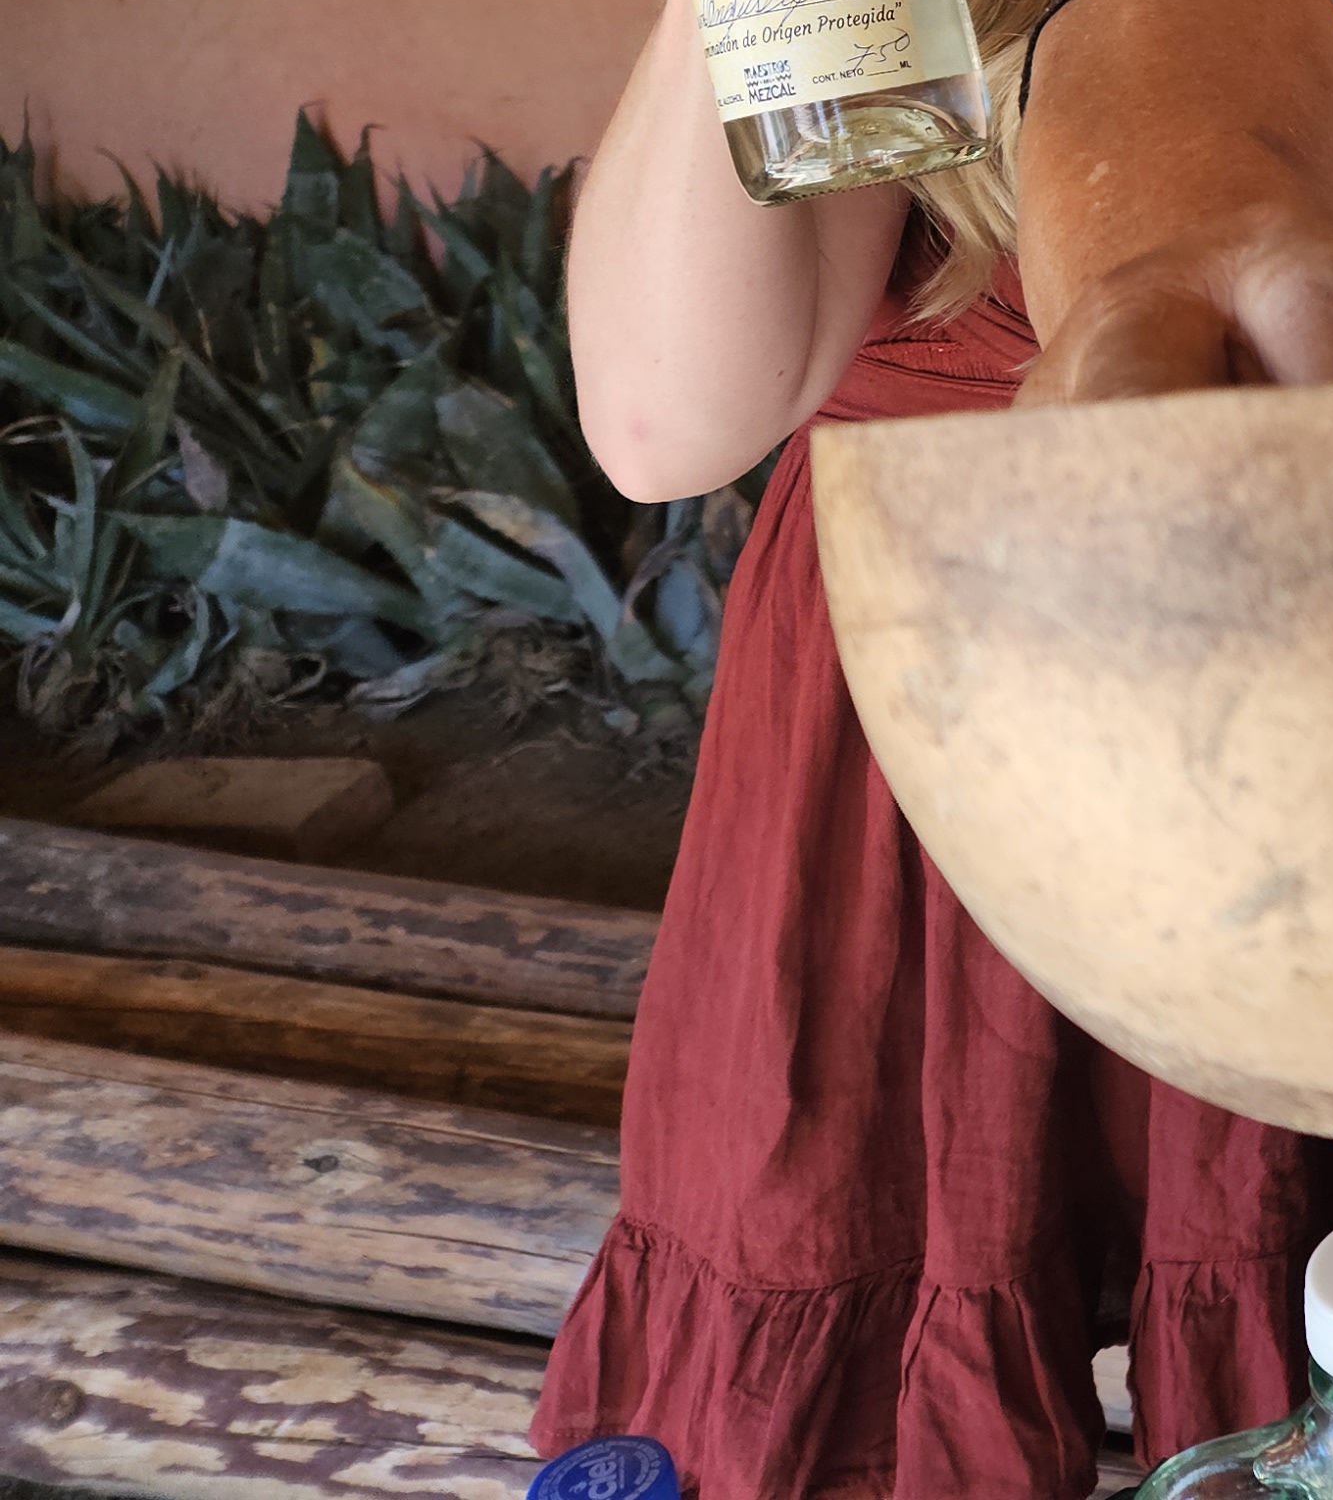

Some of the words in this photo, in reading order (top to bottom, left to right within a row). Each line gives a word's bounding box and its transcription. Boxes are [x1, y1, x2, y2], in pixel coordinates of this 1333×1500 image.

[742, 29, 757, 48] de
[762, 23, 812, 45] Origen
[812, 73, 837, 85] CONT.
[839, 67, 865, 80] NETO
